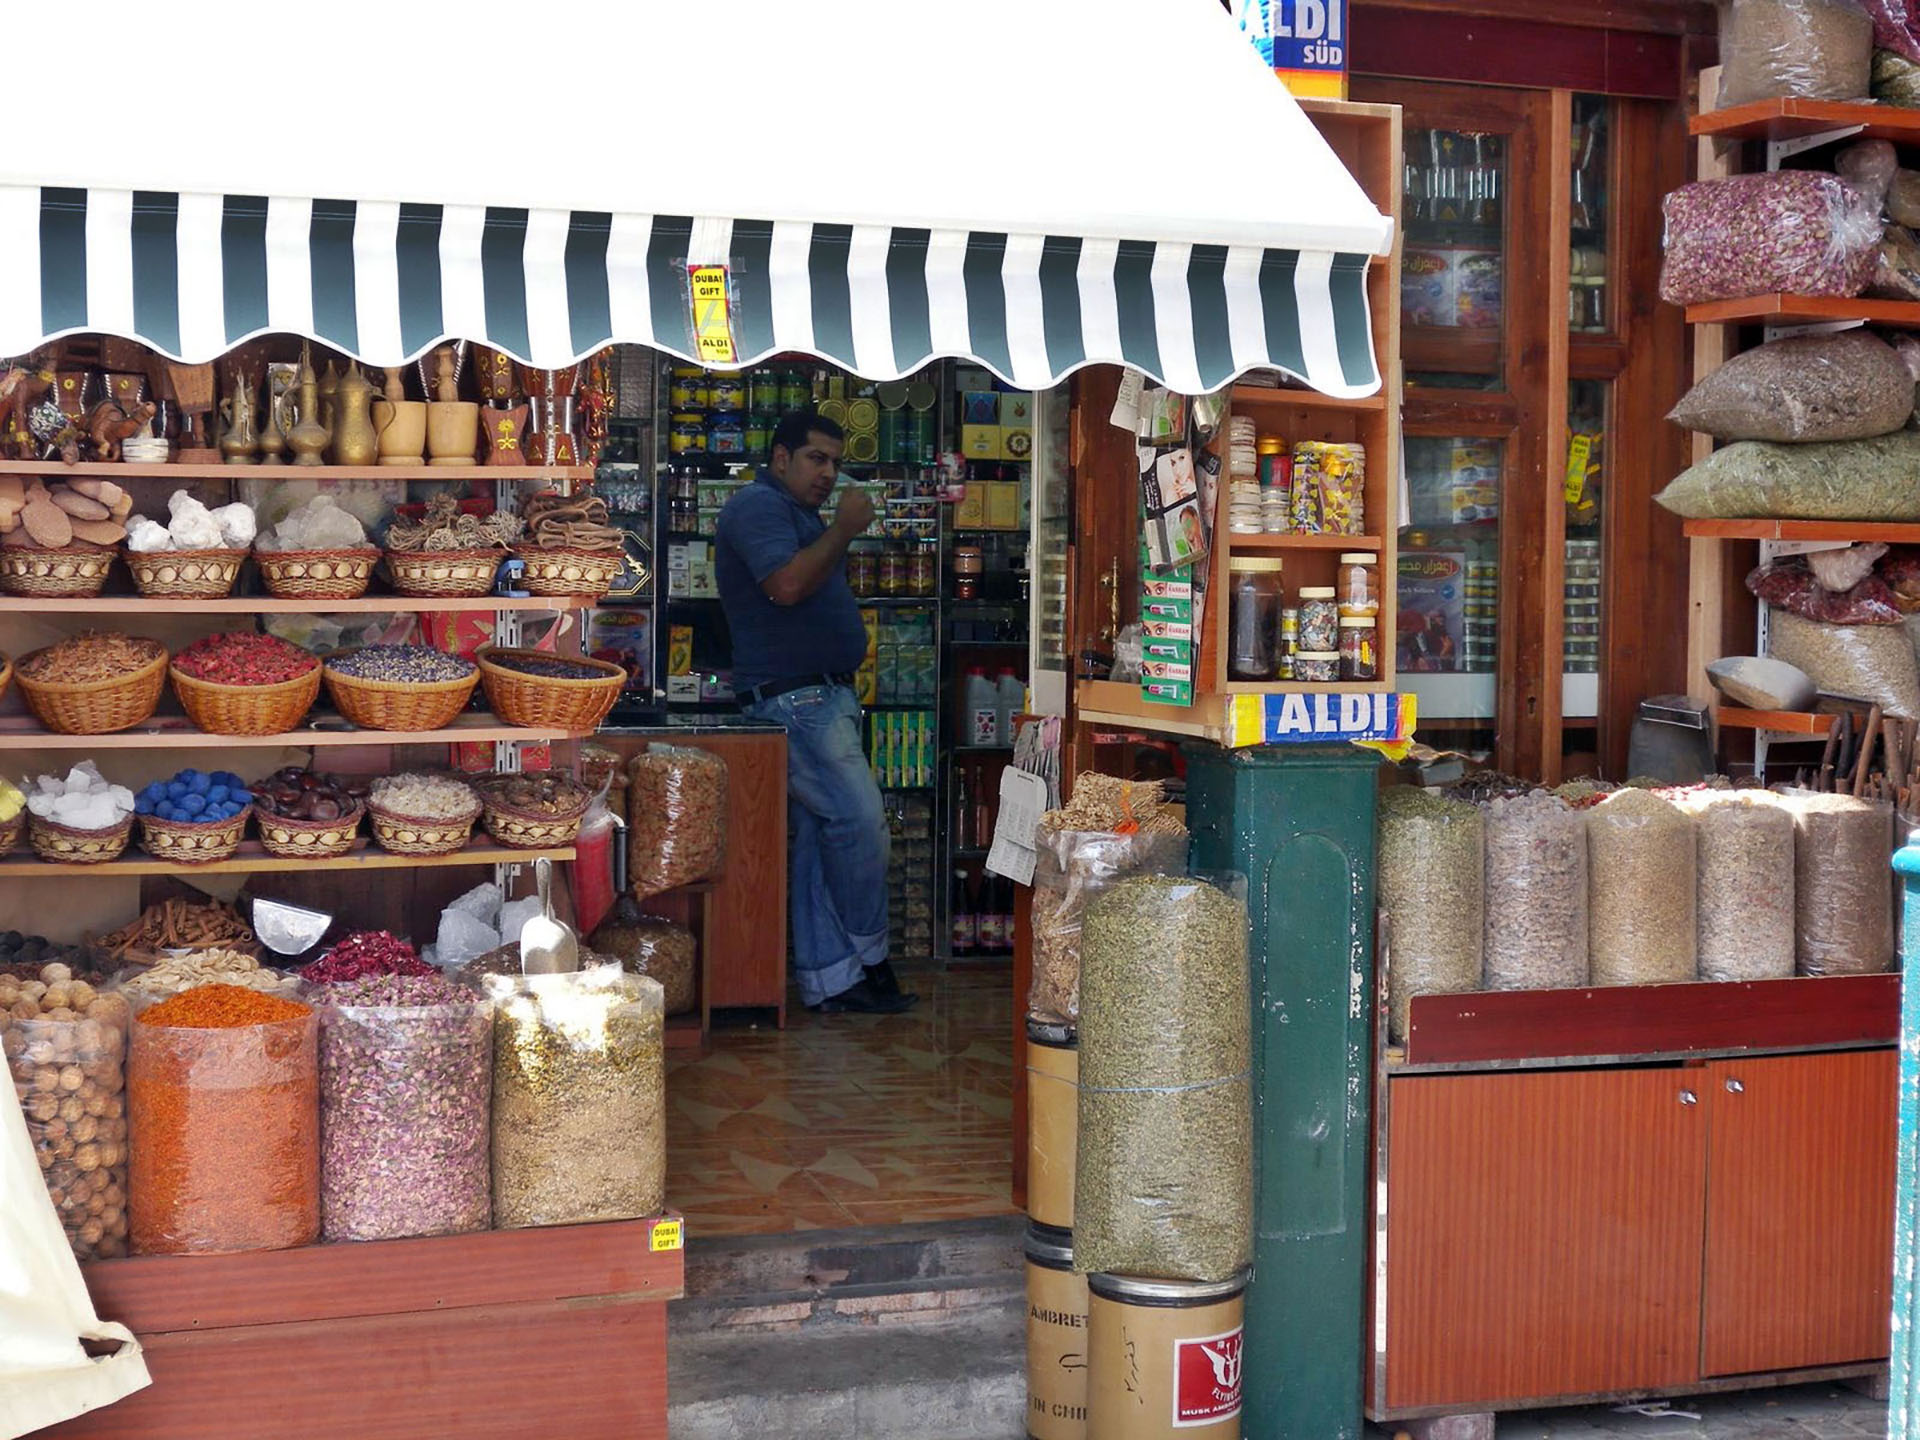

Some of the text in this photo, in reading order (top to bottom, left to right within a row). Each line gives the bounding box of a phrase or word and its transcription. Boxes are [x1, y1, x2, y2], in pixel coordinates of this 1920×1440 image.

[1303, 40, 1342, 64] SÜD
[695, 275, 722, 283] DUBAI
[699, 287, 719, 295] GIFT
[702, 339, 728, 347] ALDI
[1276, 693, 1388, 734] ALDI
[654, 1228, 678, 1236] DUBAI
[1034, 1397, 1046, 1413] IN
